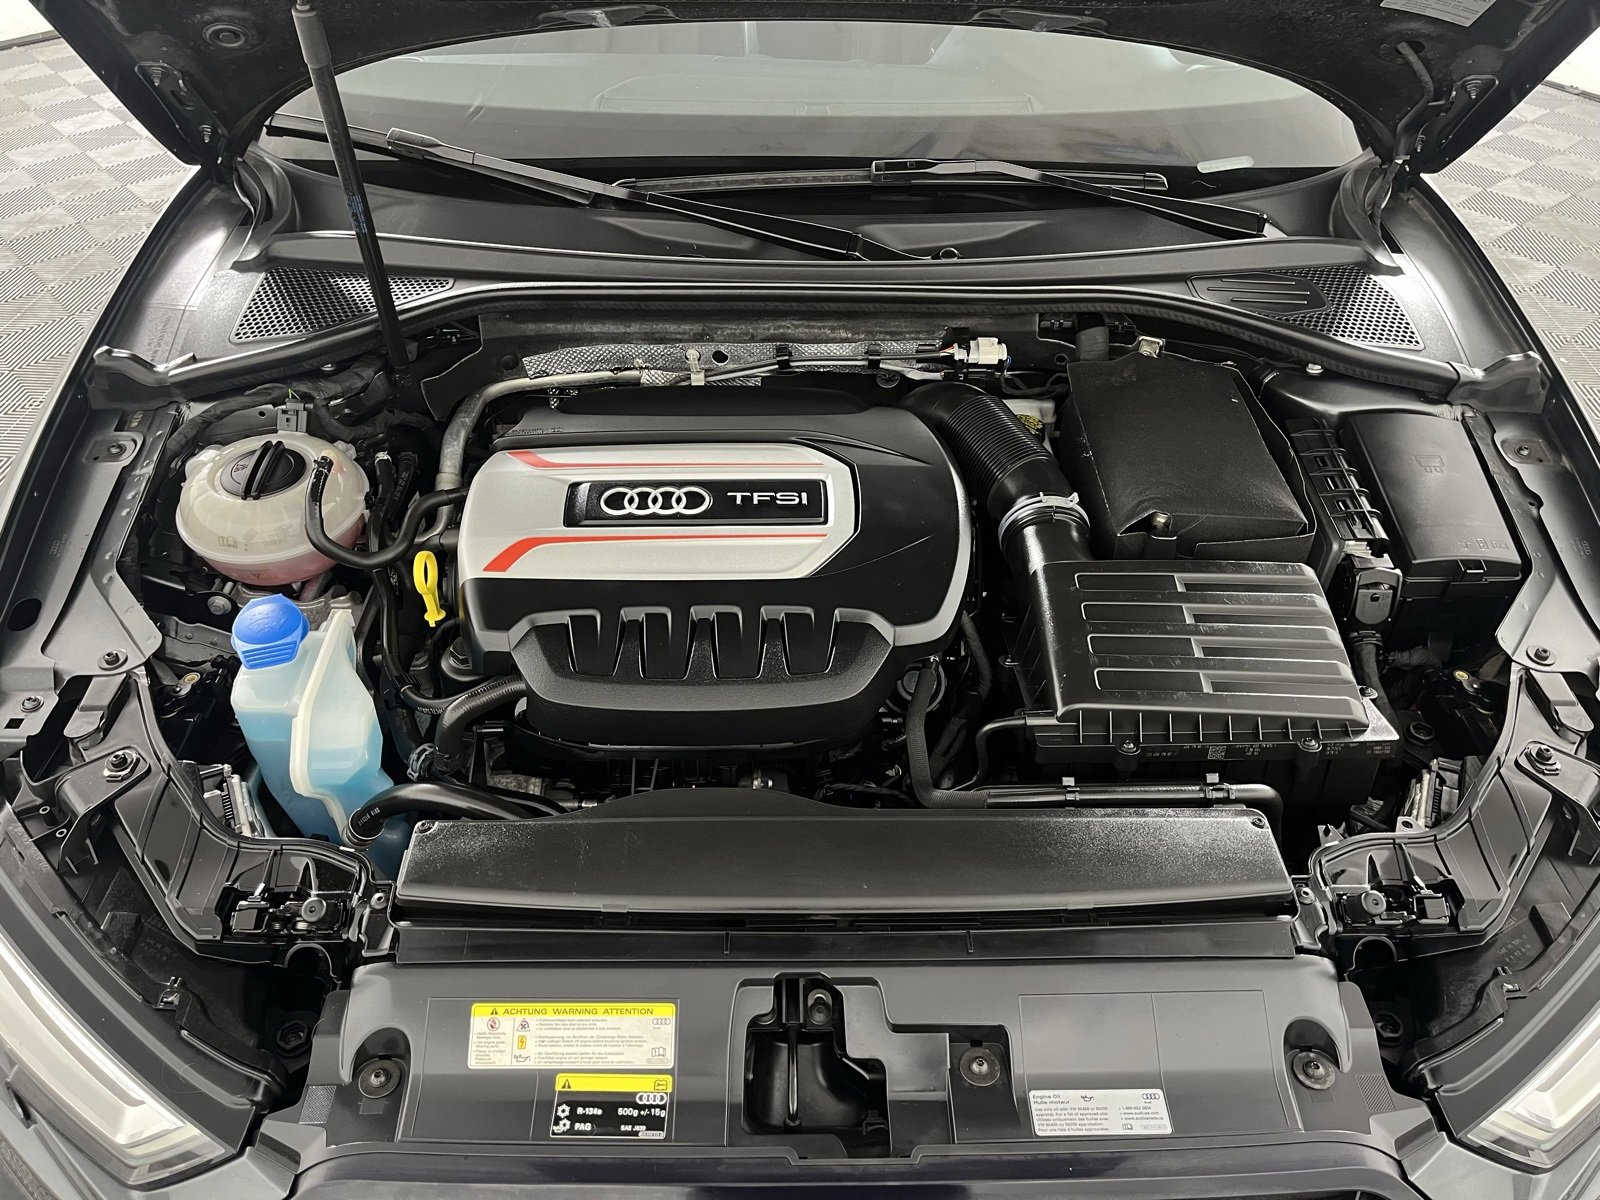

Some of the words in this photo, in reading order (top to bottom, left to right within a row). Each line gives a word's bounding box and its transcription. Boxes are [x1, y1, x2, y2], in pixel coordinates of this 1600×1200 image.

[727, 491, 808, 506] TFSI
[576, 1107, 603, 1116] R-134a
[617, 1107, 639, 1118] 500g
[650, 1108, 666, 1118] 15g
[574, 1122, 592, 1131] PAG
